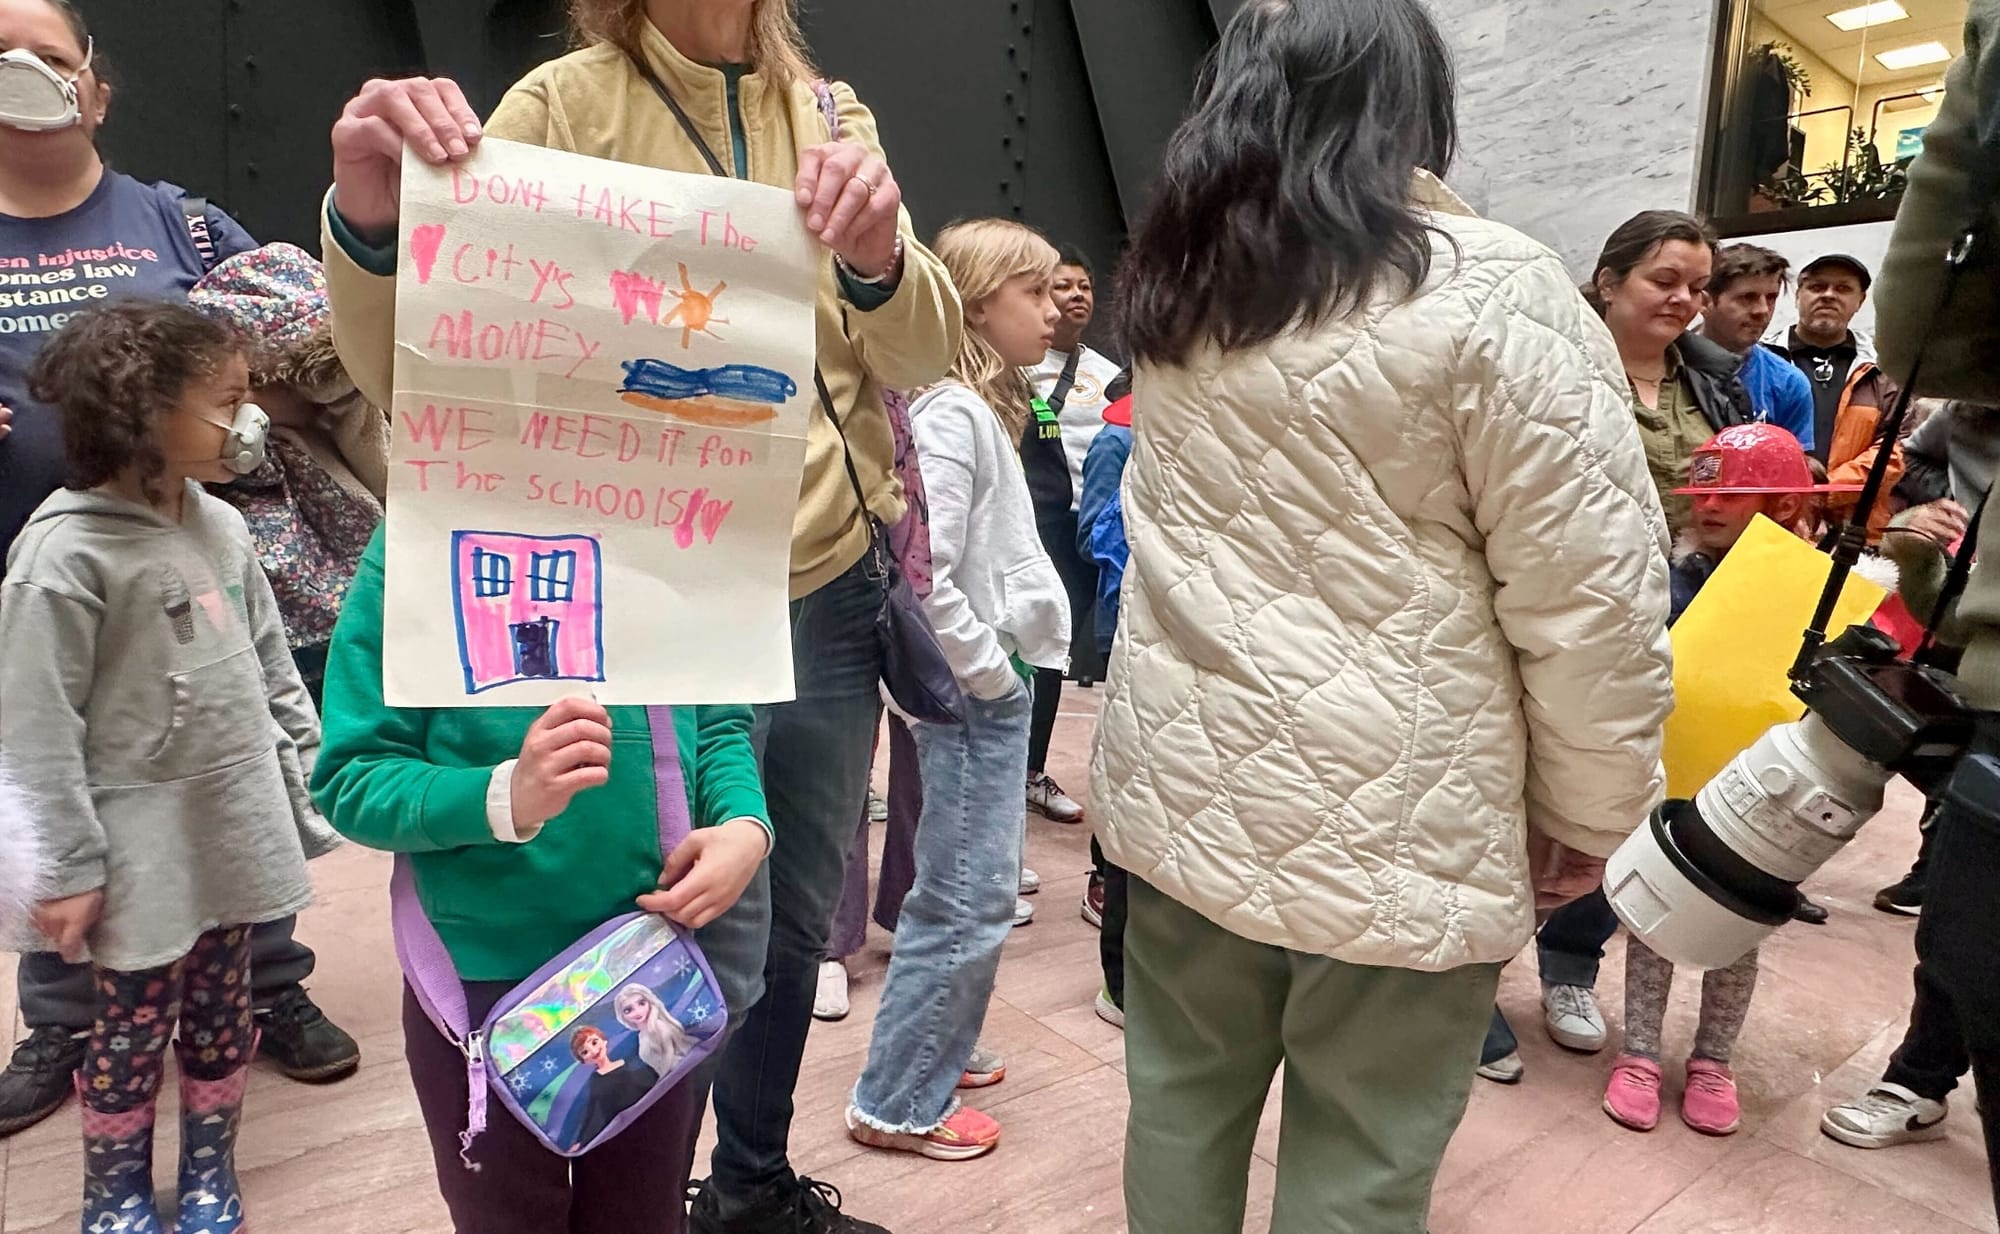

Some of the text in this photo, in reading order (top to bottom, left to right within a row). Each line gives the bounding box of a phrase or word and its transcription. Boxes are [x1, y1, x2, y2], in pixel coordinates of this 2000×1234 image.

[696, 210, 758, 253] The
[38, 241, 159, 268] injustice
[82, 263, 137, 278] law
[0, 284, 108, 308] stance
[428, 310, 600, 379] MONEY
[401, 404, 494, 452] WE
[521, 410, 639, 464] NEED
[697, 435, 753, 468] for
[404, 460, 505, 492] The
